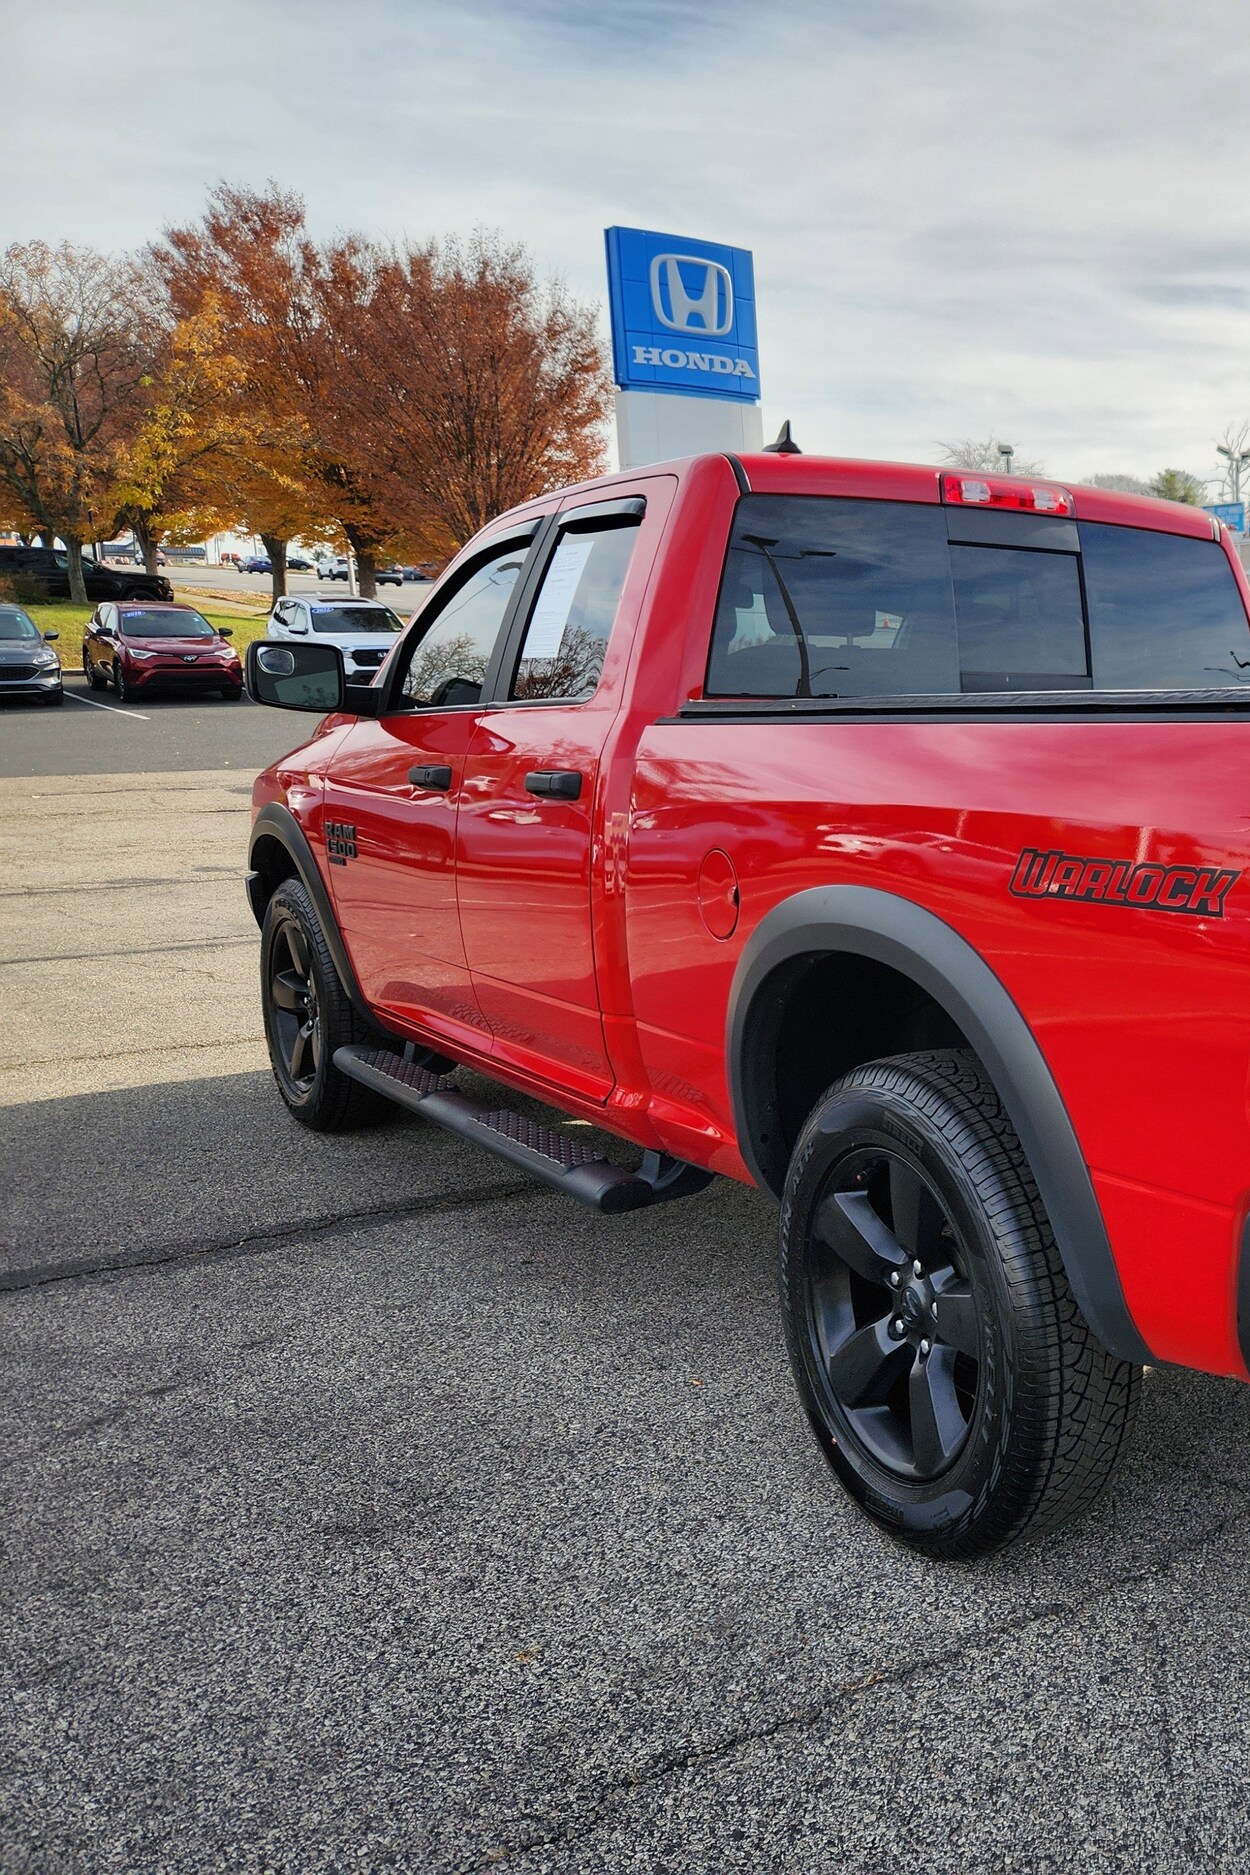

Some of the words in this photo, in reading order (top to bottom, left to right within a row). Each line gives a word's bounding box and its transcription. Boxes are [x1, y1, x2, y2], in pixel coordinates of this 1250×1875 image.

[632, 345, 756, 379] HONDA
[325, 821, 356, 841] RAM
[326, 839, 358, 859] 1500
[1008, 848, 1242, 918] WARLOCK
